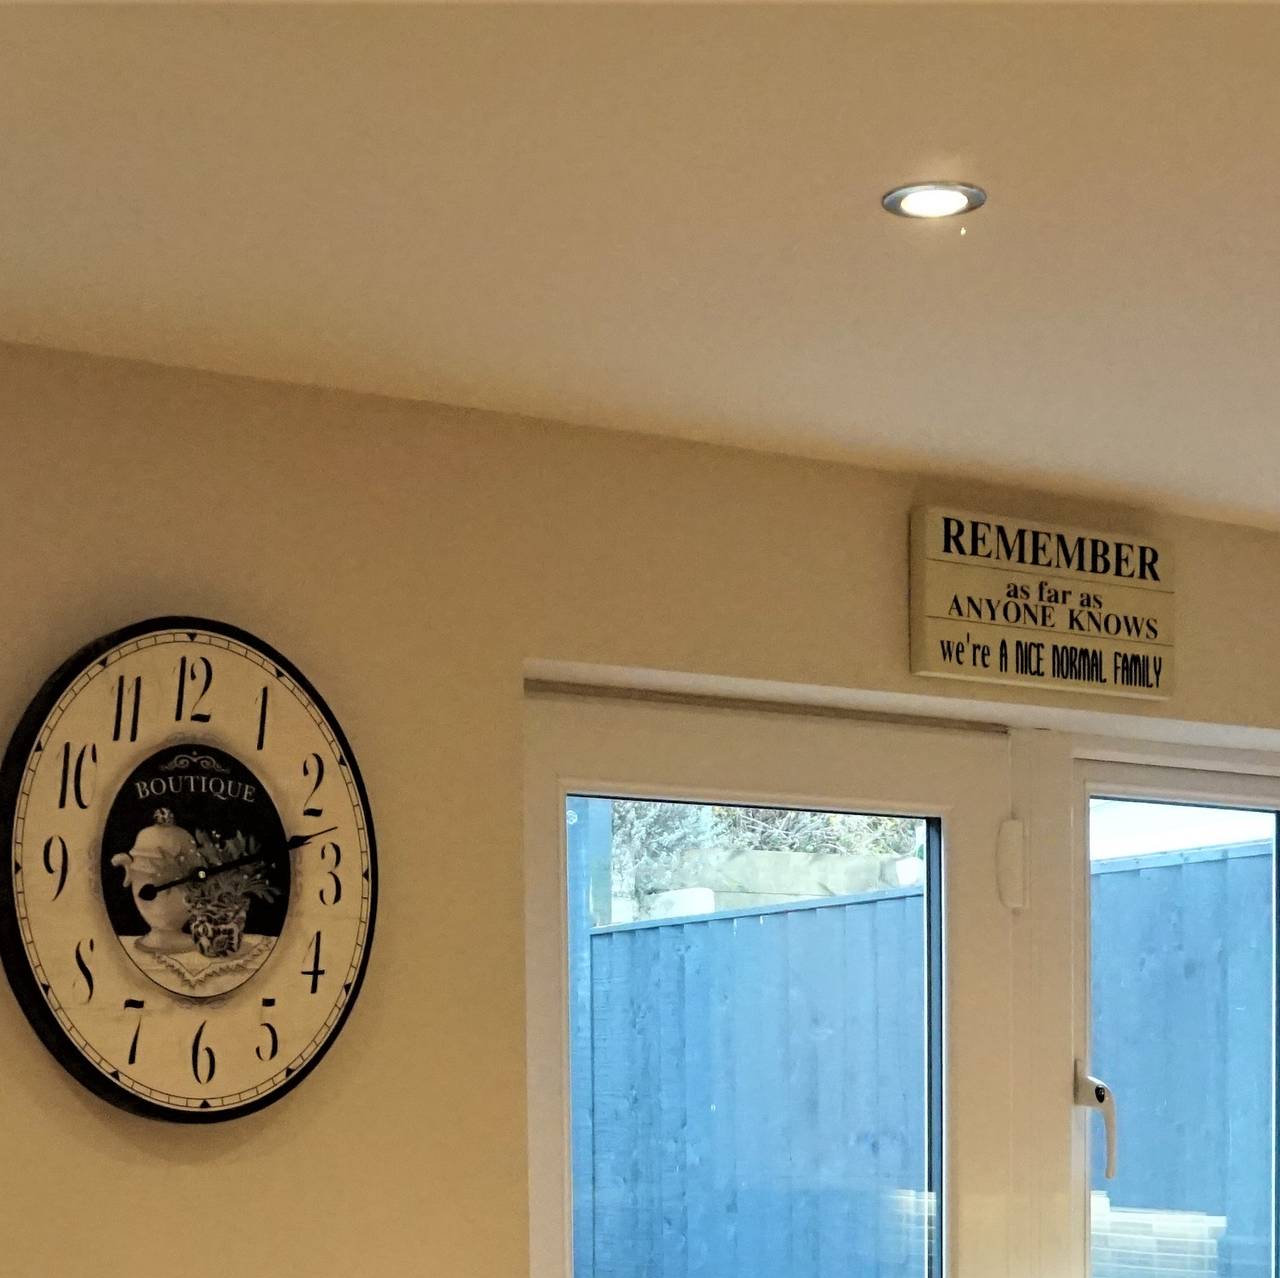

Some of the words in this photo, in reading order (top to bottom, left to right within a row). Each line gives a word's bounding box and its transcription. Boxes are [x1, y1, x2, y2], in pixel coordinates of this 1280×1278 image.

[942, 516, 1161, 582] REMEMBER
[947, 593, 1056, 629] ANYONE
[1067, 607, 1159, 641] KNOWS
[1006, 582, 1031, 601] as
[1037, 580, 1072, 605] far
[1079, 591, 1104, 610] as
[173, 655, 213, 723] 12
[940, 631, 991, 669] we're
[999, 638, 1009, 673] A
[1015, 640, 1045, 678] NICE
[1052, 643, 1107, 685] NORMAL
[1113, 650, 1162, 689] FAMILY
[111, 674, 142, 742] 11
[256, 685, 269, 751] 1
[57, 741, 98, 810] 10
[135, 775, 256, 803] BOUTIQUE
[302, 752, 325, 818] 2
[42, 834, 69, 902] 9
[319, 841, 342, 906] 3
[301, 930, 326, 995] 4
[123, 997, 145, 1065] 7
[191, 1019, 216, 1085] 6
[255, 996, 279, 1063] 5
